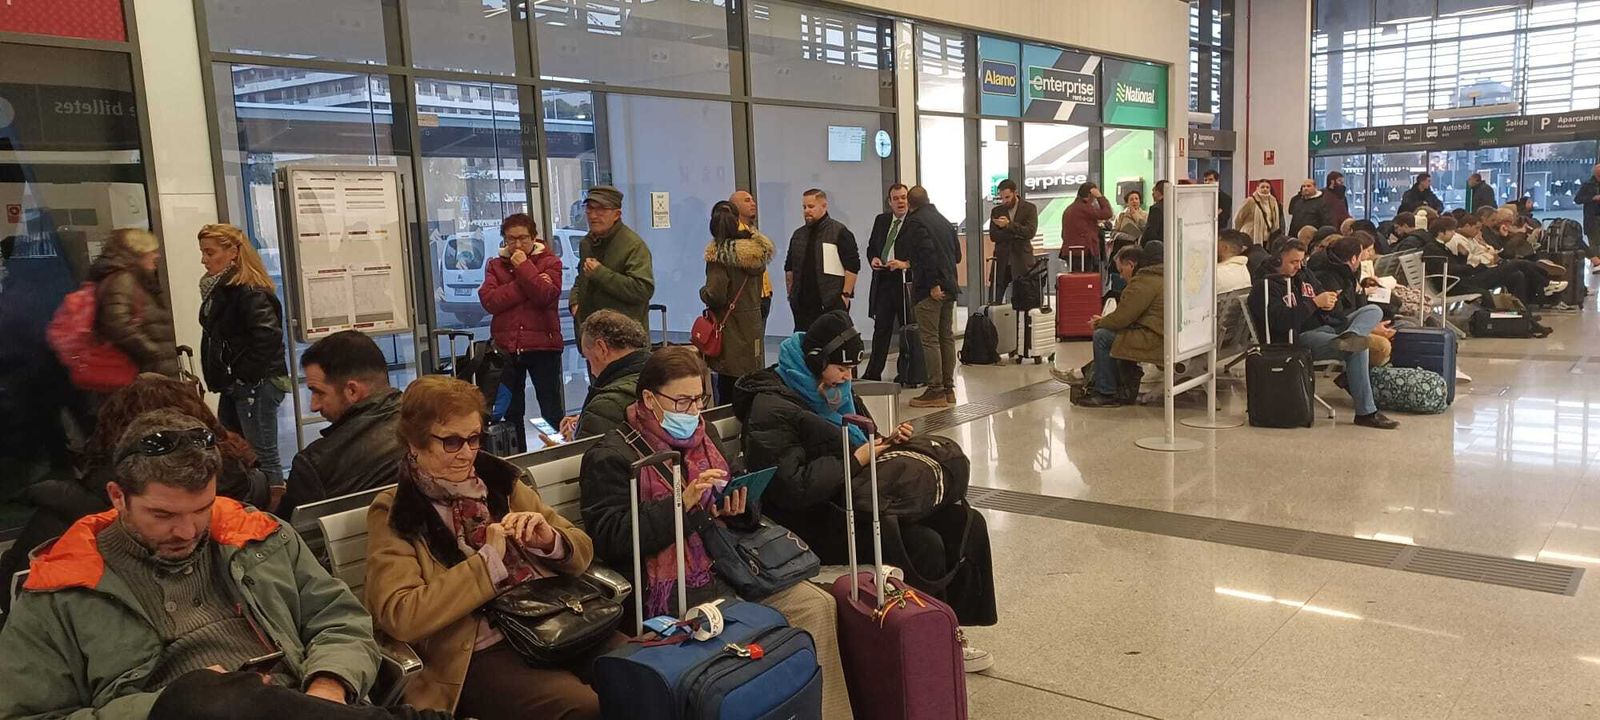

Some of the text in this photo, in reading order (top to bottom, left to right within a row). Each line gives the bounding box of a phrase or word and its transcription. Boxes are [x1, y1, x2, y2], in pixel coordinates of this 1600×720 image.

[984, 69, 1016, 87] Alamo
[1032, 75, 1094, 97] enterprise
[1125, 86, 1155, 104] National
[1505, 119, 1528, 127] Salida
[1558, 114, 1600, 124] Aparcamie
[1345, 132, 1354, 143] A
[1357, 130, 1377, 138] Salida
